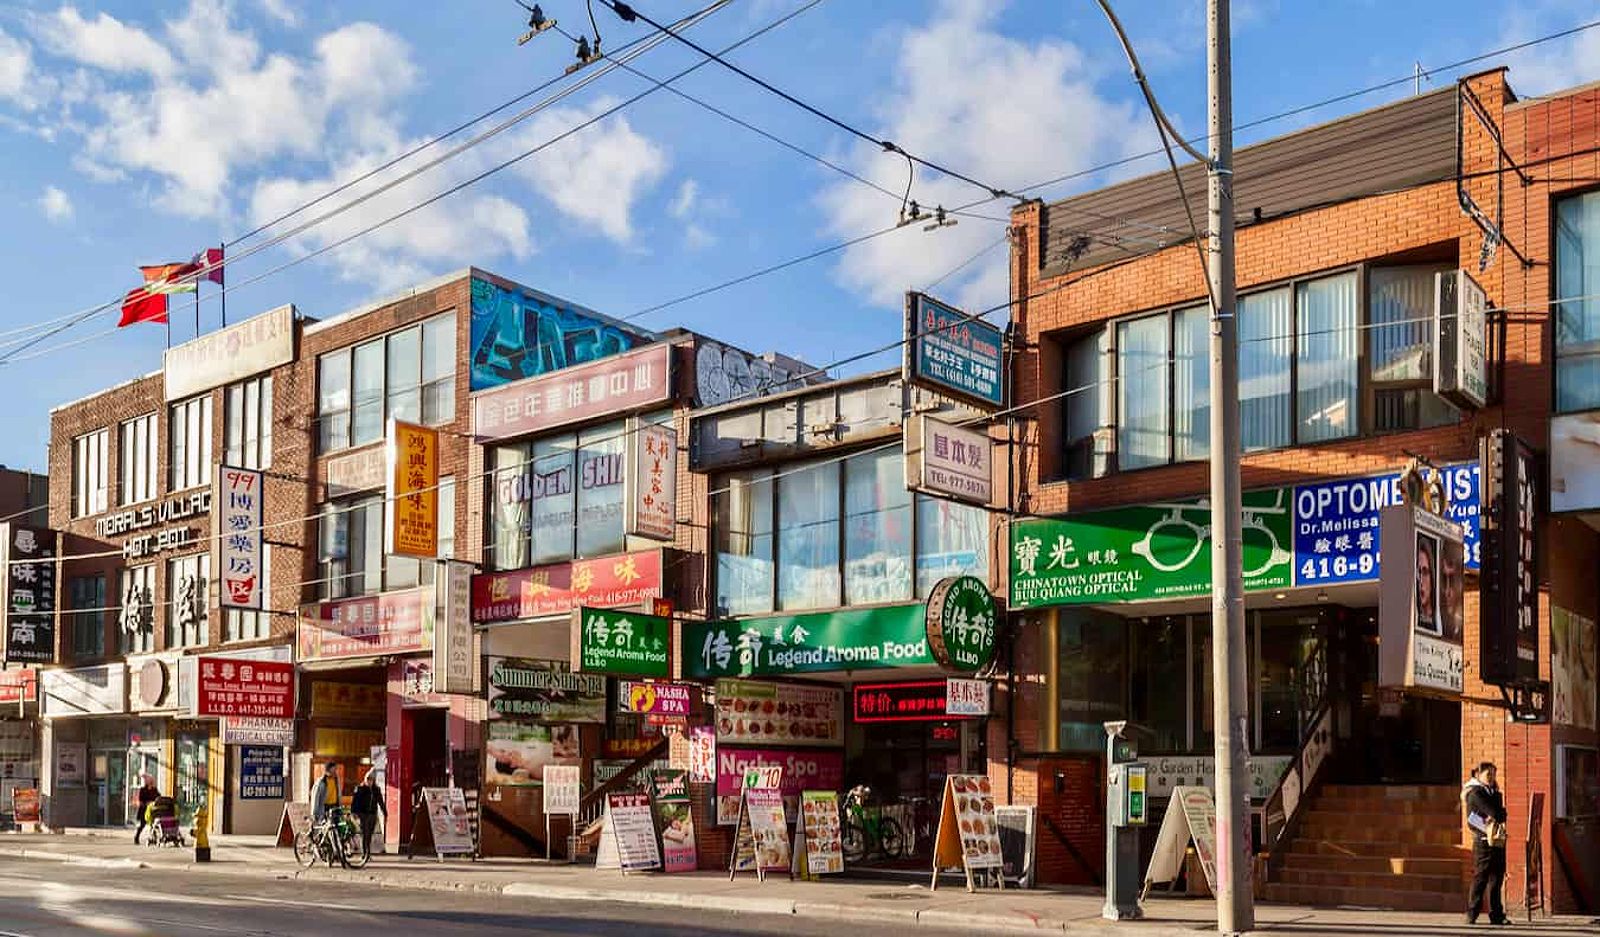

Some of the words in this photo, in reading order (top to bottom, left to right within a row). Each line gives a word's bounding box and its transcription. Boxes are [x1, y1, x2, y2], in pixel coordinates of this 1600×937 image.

[500, 463, 572, 504] GOLDEN
[1298, 468, 1480, 519] OPTOMEIST
[1449, 503, 1480, 517] Yue
[122, 534, 152, 560] HOT
[156, 527, 189, 552] POT
[1014, 574, 1086, 589] CHINATOWN
[1089, 570, 1142, 584] OPTICAL
[1040, 586, 1081, 601] QUANG
[1084, 581, 1138, 595] OPTICAL
[584, 645, 616, 659] Legend
[616, 648, 644, 661] Aroma
[645, 651, 666, 663] Food
[768, 648, 822, 668] Legend
[825, 646, 880, 664] Aroma
[883, 638, 927, 660] Food
[493, 664, 549, 690] Summer
[662, 700, 684, 712] SPA
[786, 756, 818, 778] Spa
